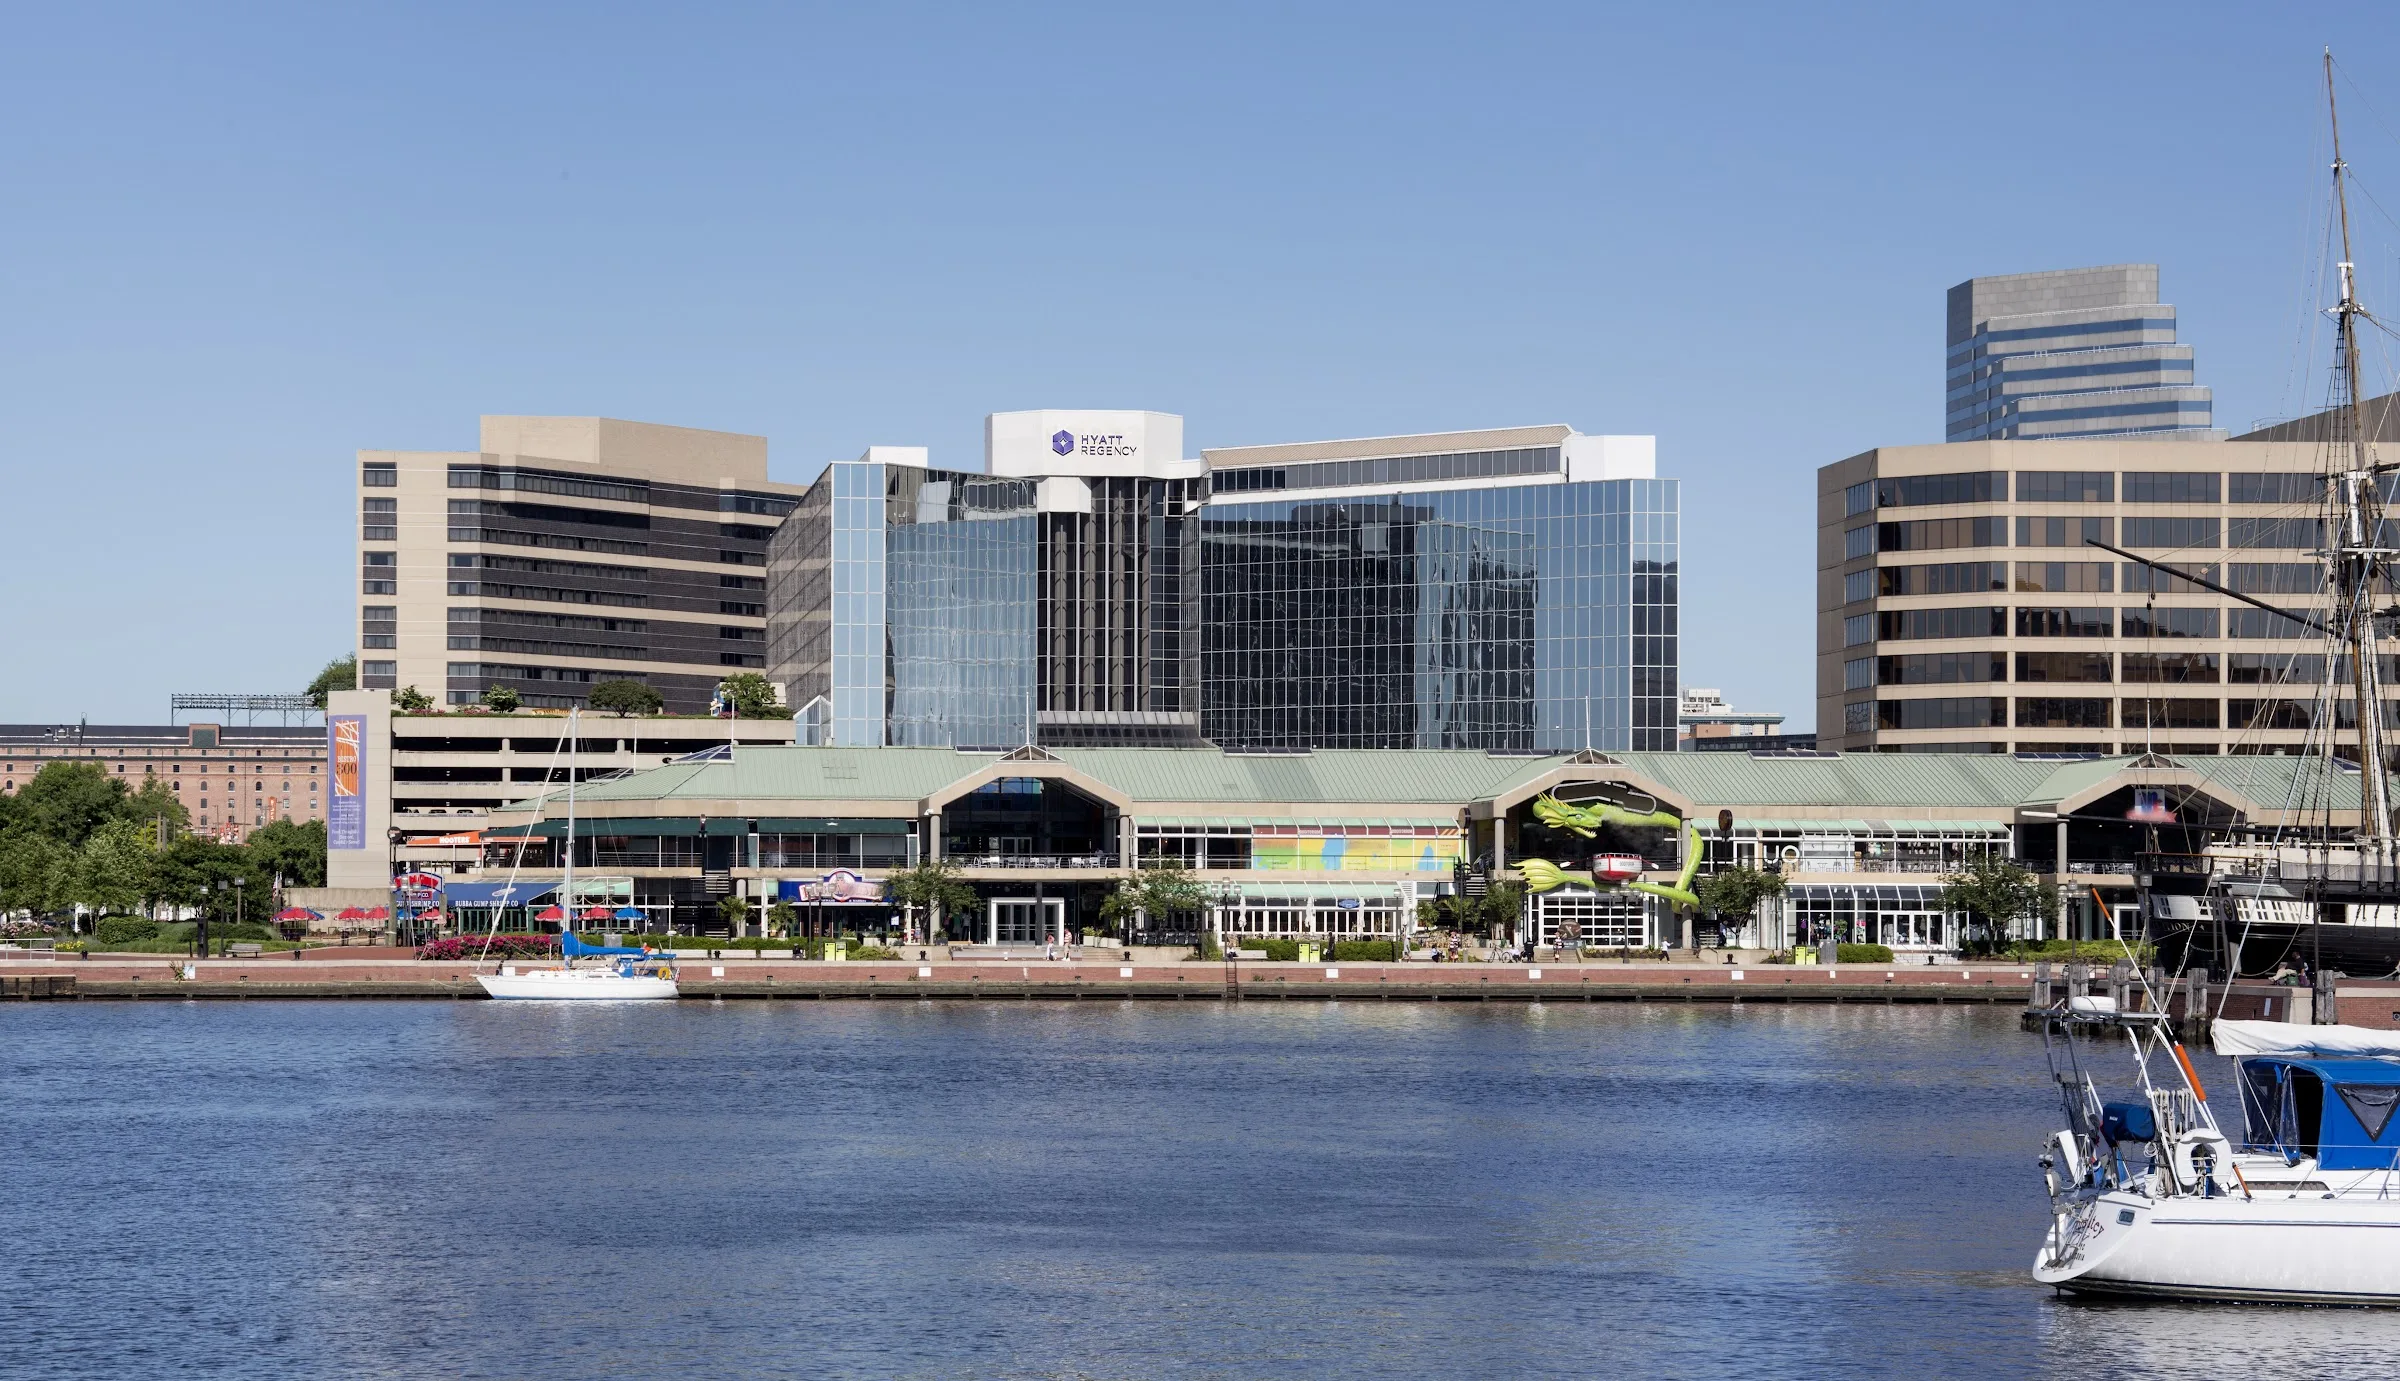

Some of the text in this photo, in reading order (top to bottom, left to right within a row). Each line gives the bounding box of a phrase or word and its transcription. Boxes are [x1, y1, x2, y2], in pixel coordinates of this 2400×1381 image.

[1081, 435, 1123, 445] HYATT
[1081, 446, 1137, 456] REGENCY
[439, 836, 470, 844] HOOTERS
